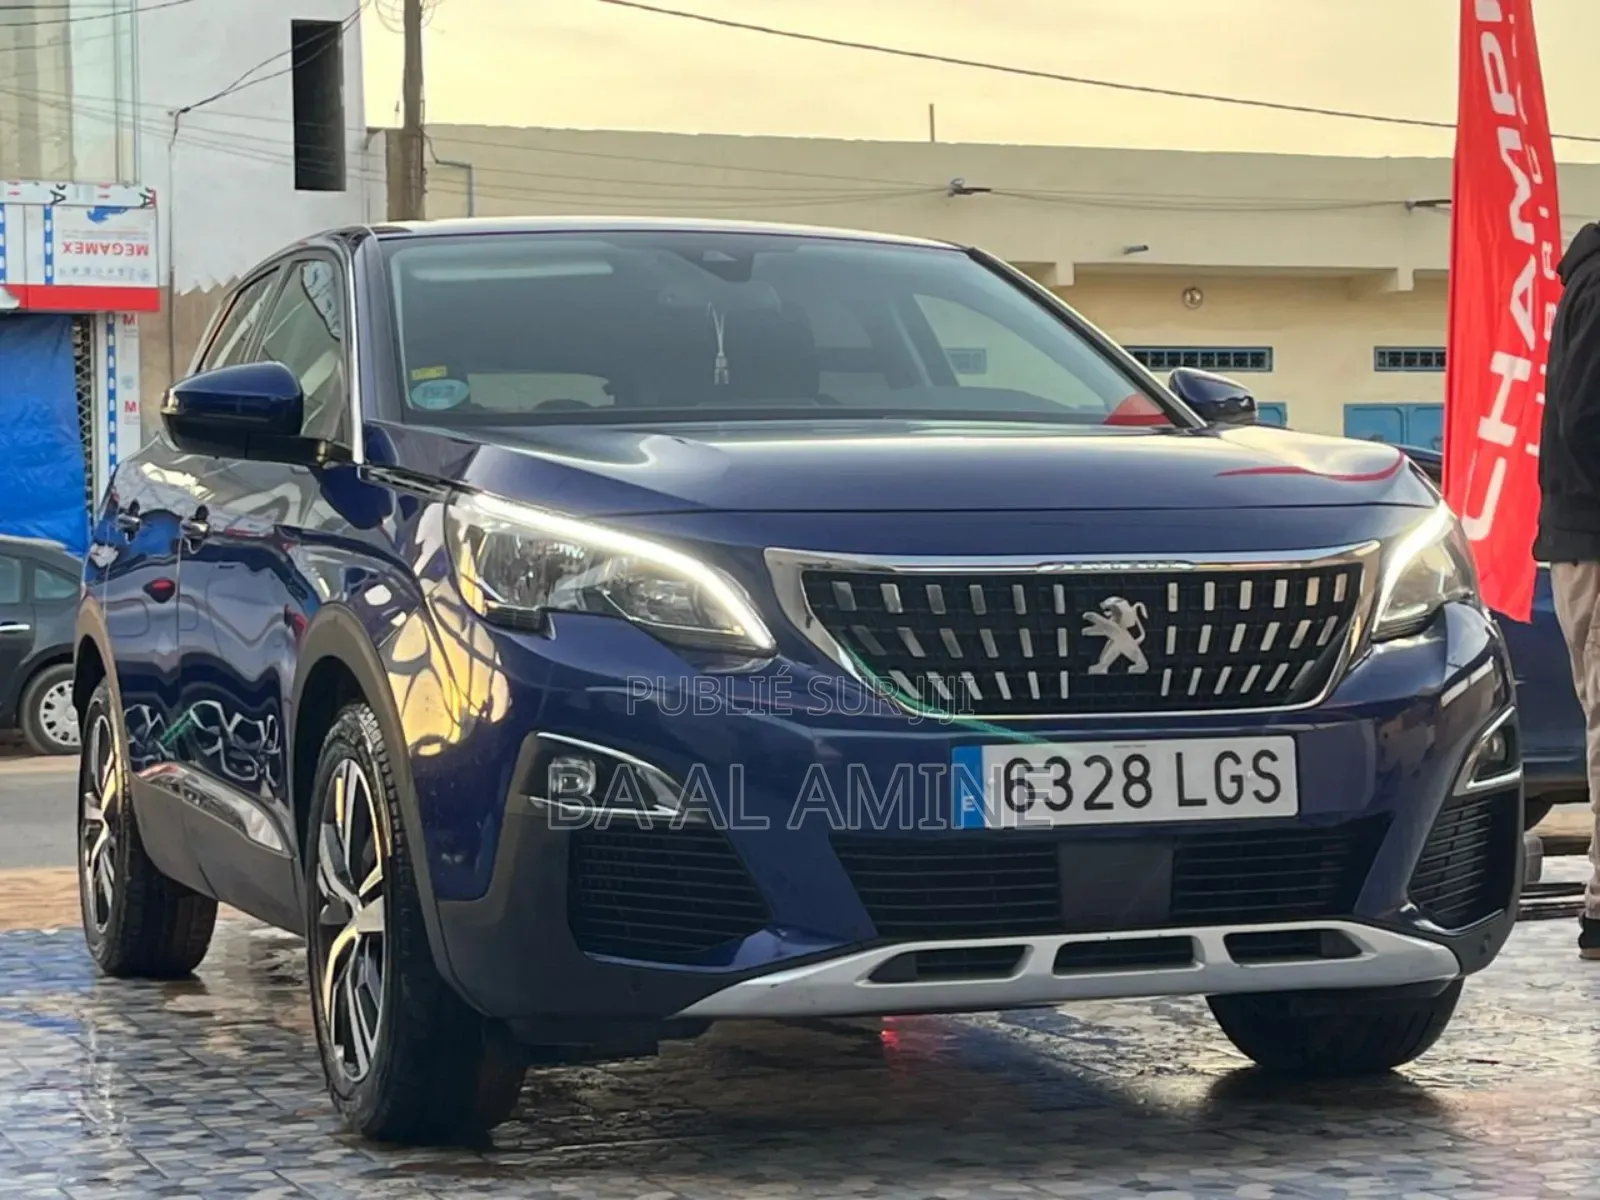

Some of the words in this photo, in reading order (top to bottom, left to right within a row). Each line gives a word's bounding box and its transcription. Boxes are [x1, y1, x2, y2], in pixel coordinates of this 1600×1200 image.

[62, 241, 149, 256] MEGAMEX
[1003, 753, 1153, 813] 6328
[1175, 749, 1281, 808] LGS
[961, 796, 976, 812] E
